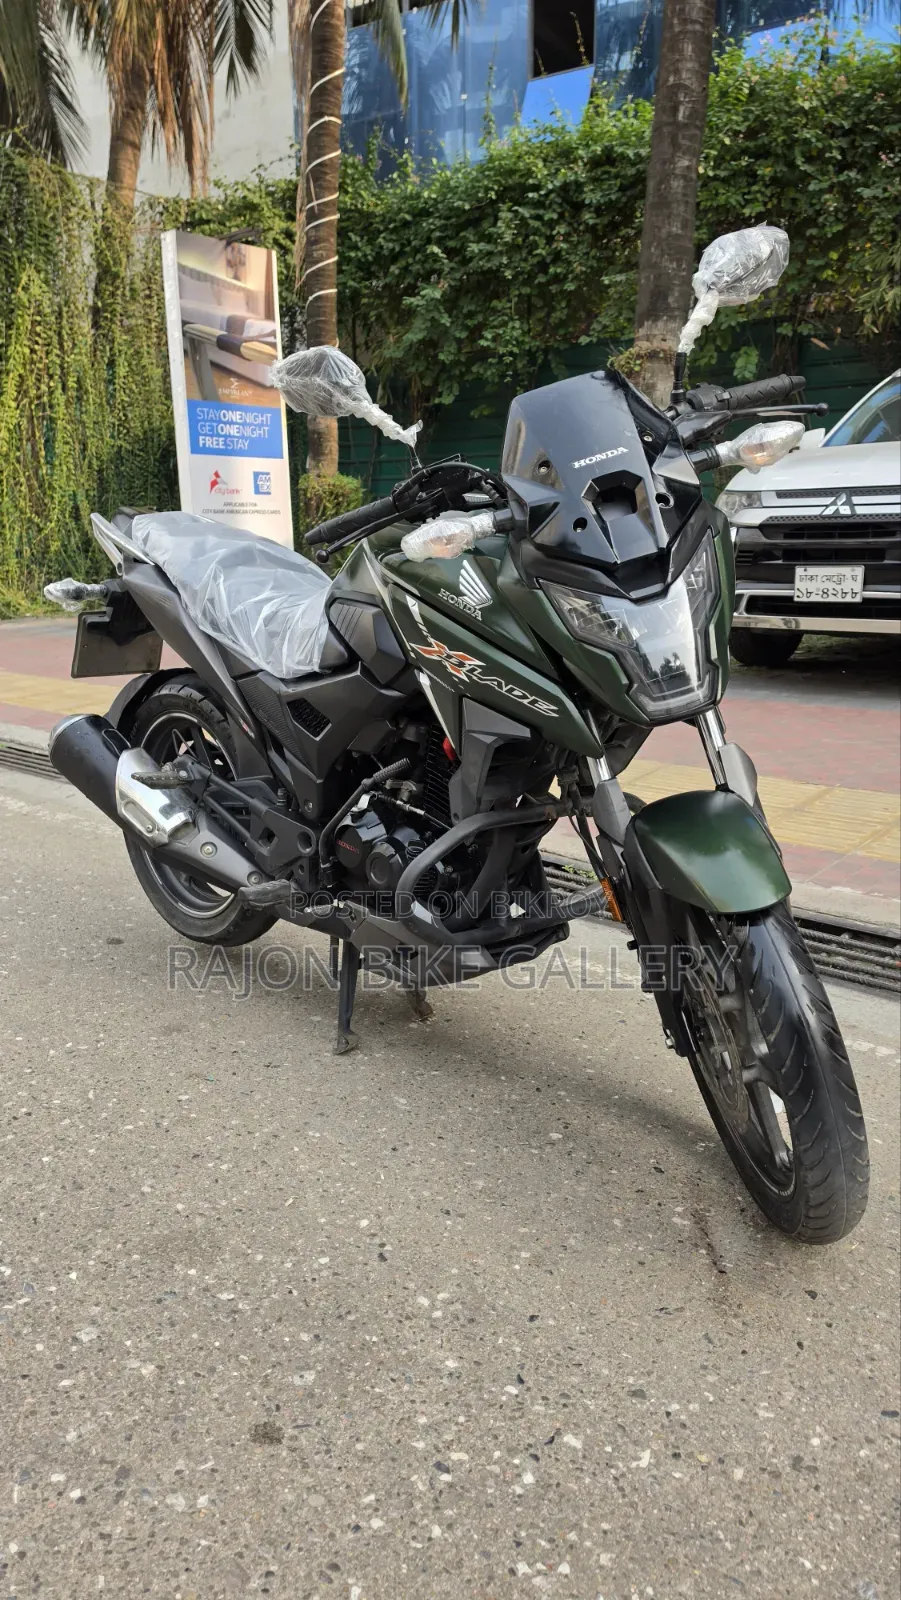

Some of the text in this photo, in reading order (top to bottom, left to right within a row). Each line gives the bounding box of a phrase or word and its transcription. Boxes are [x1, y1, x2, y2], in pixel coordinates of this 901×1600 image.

[199, 436, 249, 450] FREE STAY
[572, 446, 629, 469] HONDA
[257, 475, 271, 484] AM
[259, 484, 271, 492] EX
[799, 574, 818, 582] ঢাকা
[796, 587, 859, 599] ১৮-৪২৮৮
[438, 588, 482, 621] HONDA
